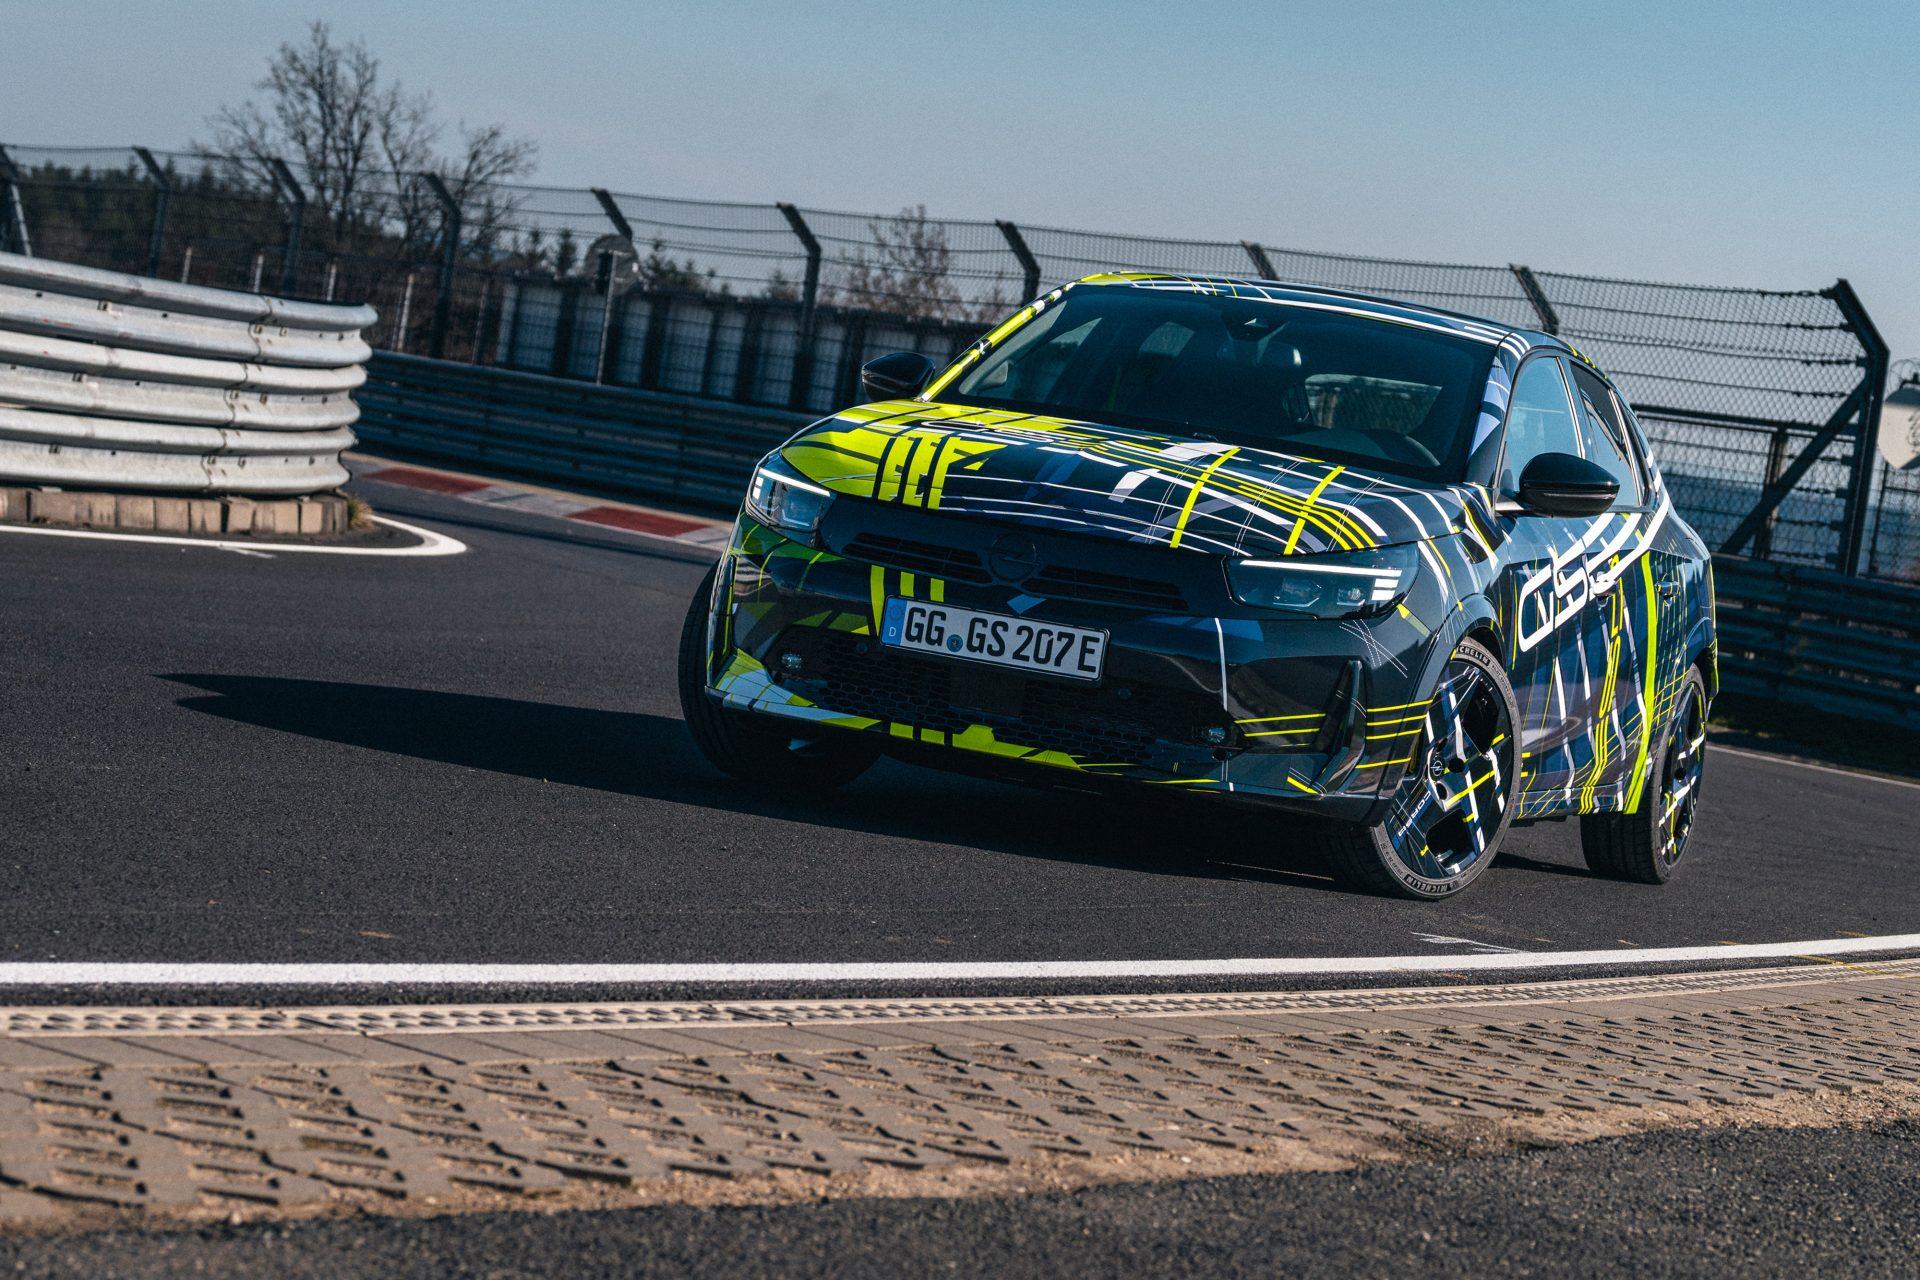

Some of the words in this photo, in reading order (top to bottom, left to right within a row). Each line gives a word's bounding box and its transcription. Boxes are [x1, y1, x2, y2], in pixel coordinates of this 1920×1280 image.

[888, 626, 897, 637] D
[904, 606, 947, 647] GG
[966, 617, 1009, 656] GS
[1406, 875, 1449, 893] MICHELIN
